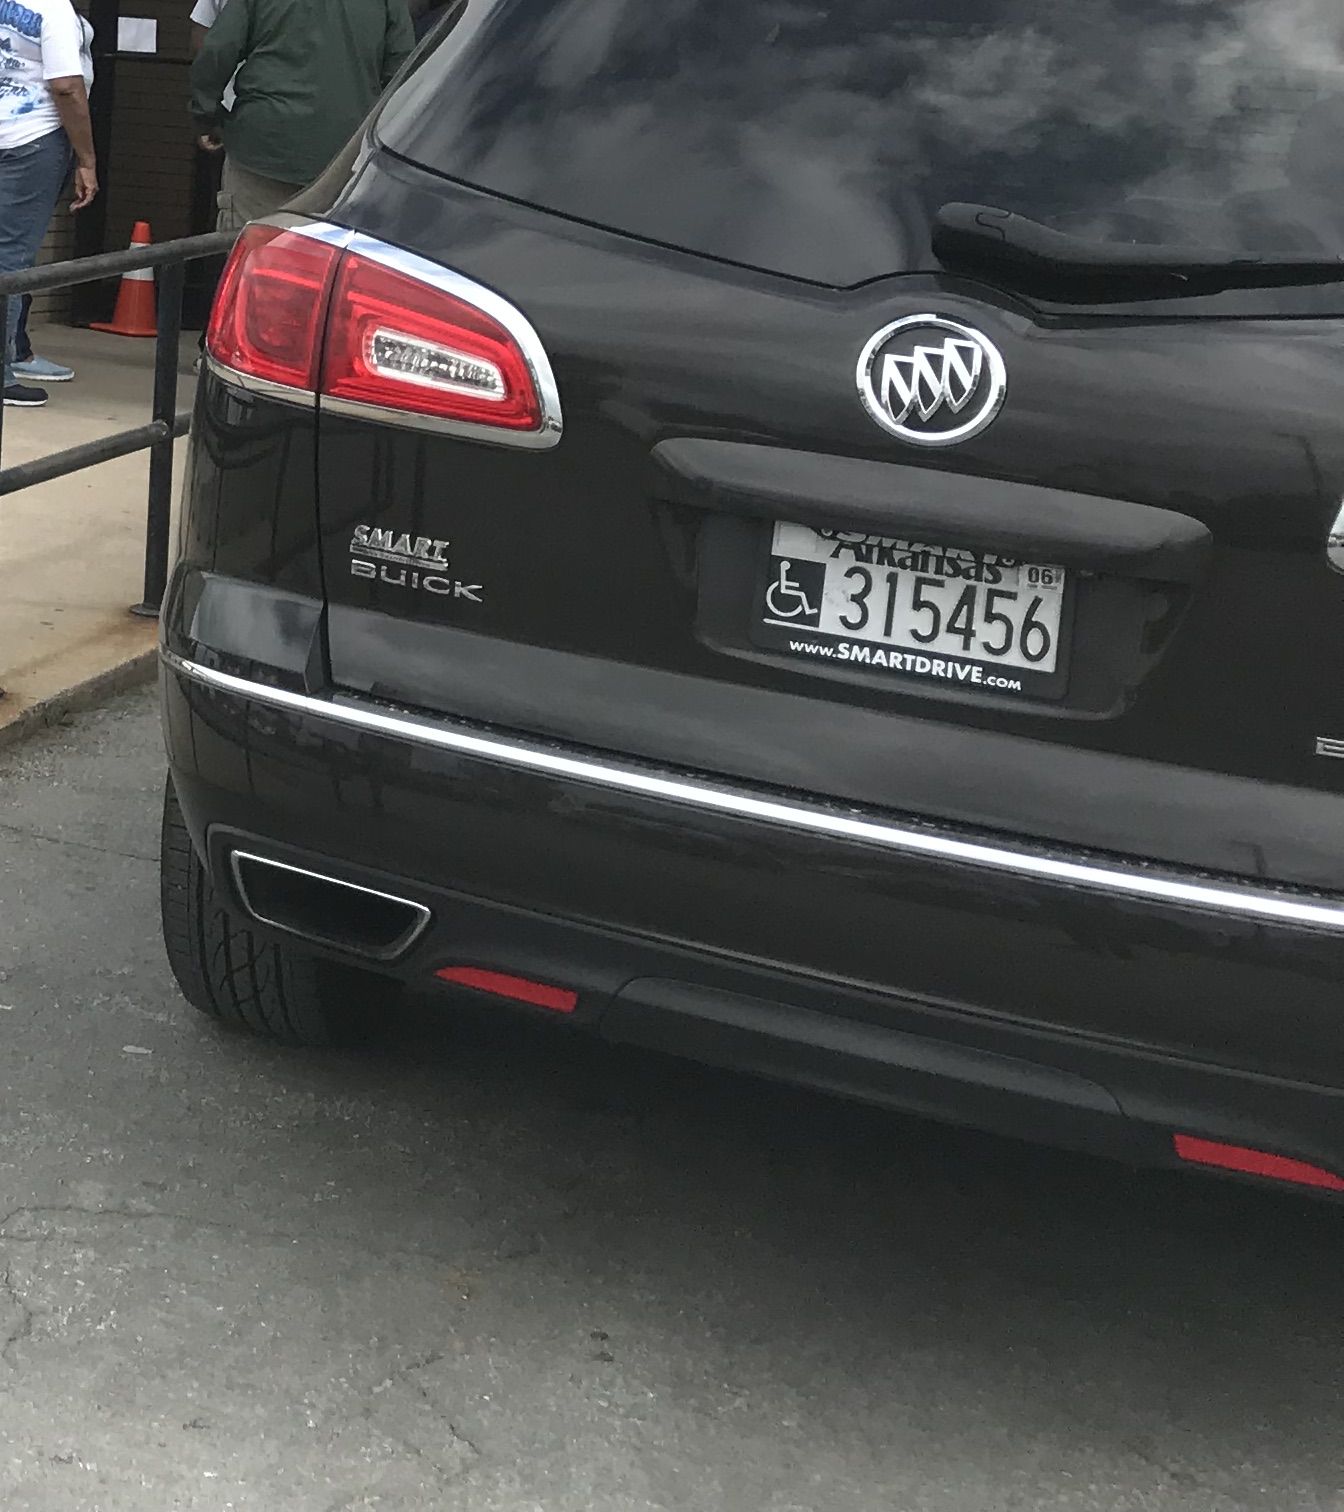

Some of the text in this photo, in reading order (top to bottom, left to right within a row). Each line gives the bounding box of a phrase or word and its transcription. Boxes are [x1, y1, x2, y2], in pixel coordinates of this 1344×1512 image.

[351, 524, 450, 562] SMART
[351, 559, 483, 602] BUICK
[839, 565, 1052, 662] 315456
